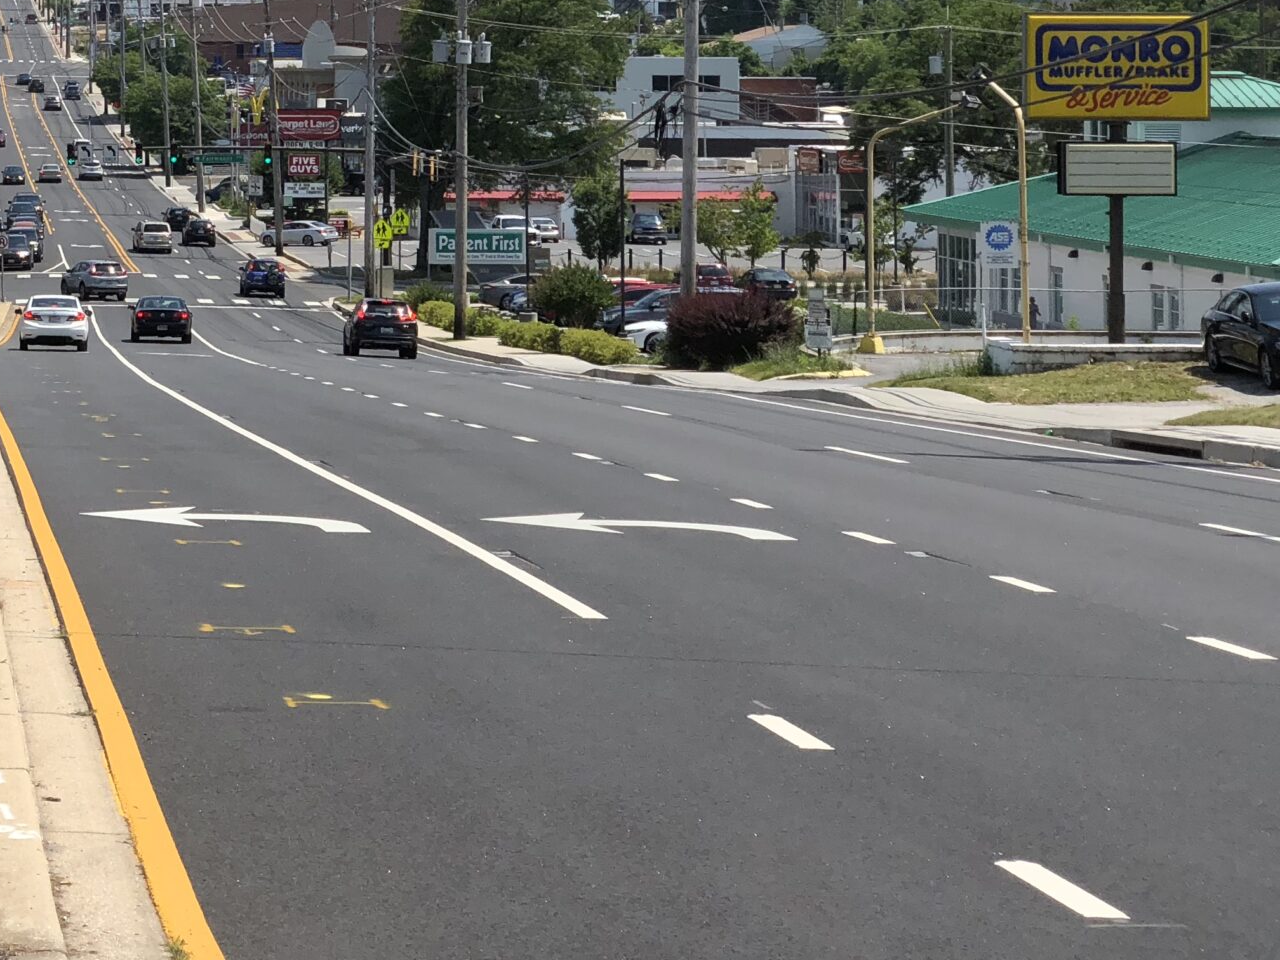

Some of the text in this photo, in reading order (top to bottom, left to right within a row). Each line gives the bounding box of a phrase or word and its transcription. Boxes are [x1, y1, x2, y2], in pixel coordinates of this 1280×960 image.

[1047, 35, 1190, 63] MONRO
[1049, 65, 1190, 78] MUFFLER/BRAKE
[1085, 83, 1172, 112] Service
[292, 156, 316, 164] FIVE
[289, 166, 319, 174] GUYS
[439, 235, 520, 251] Paent First
